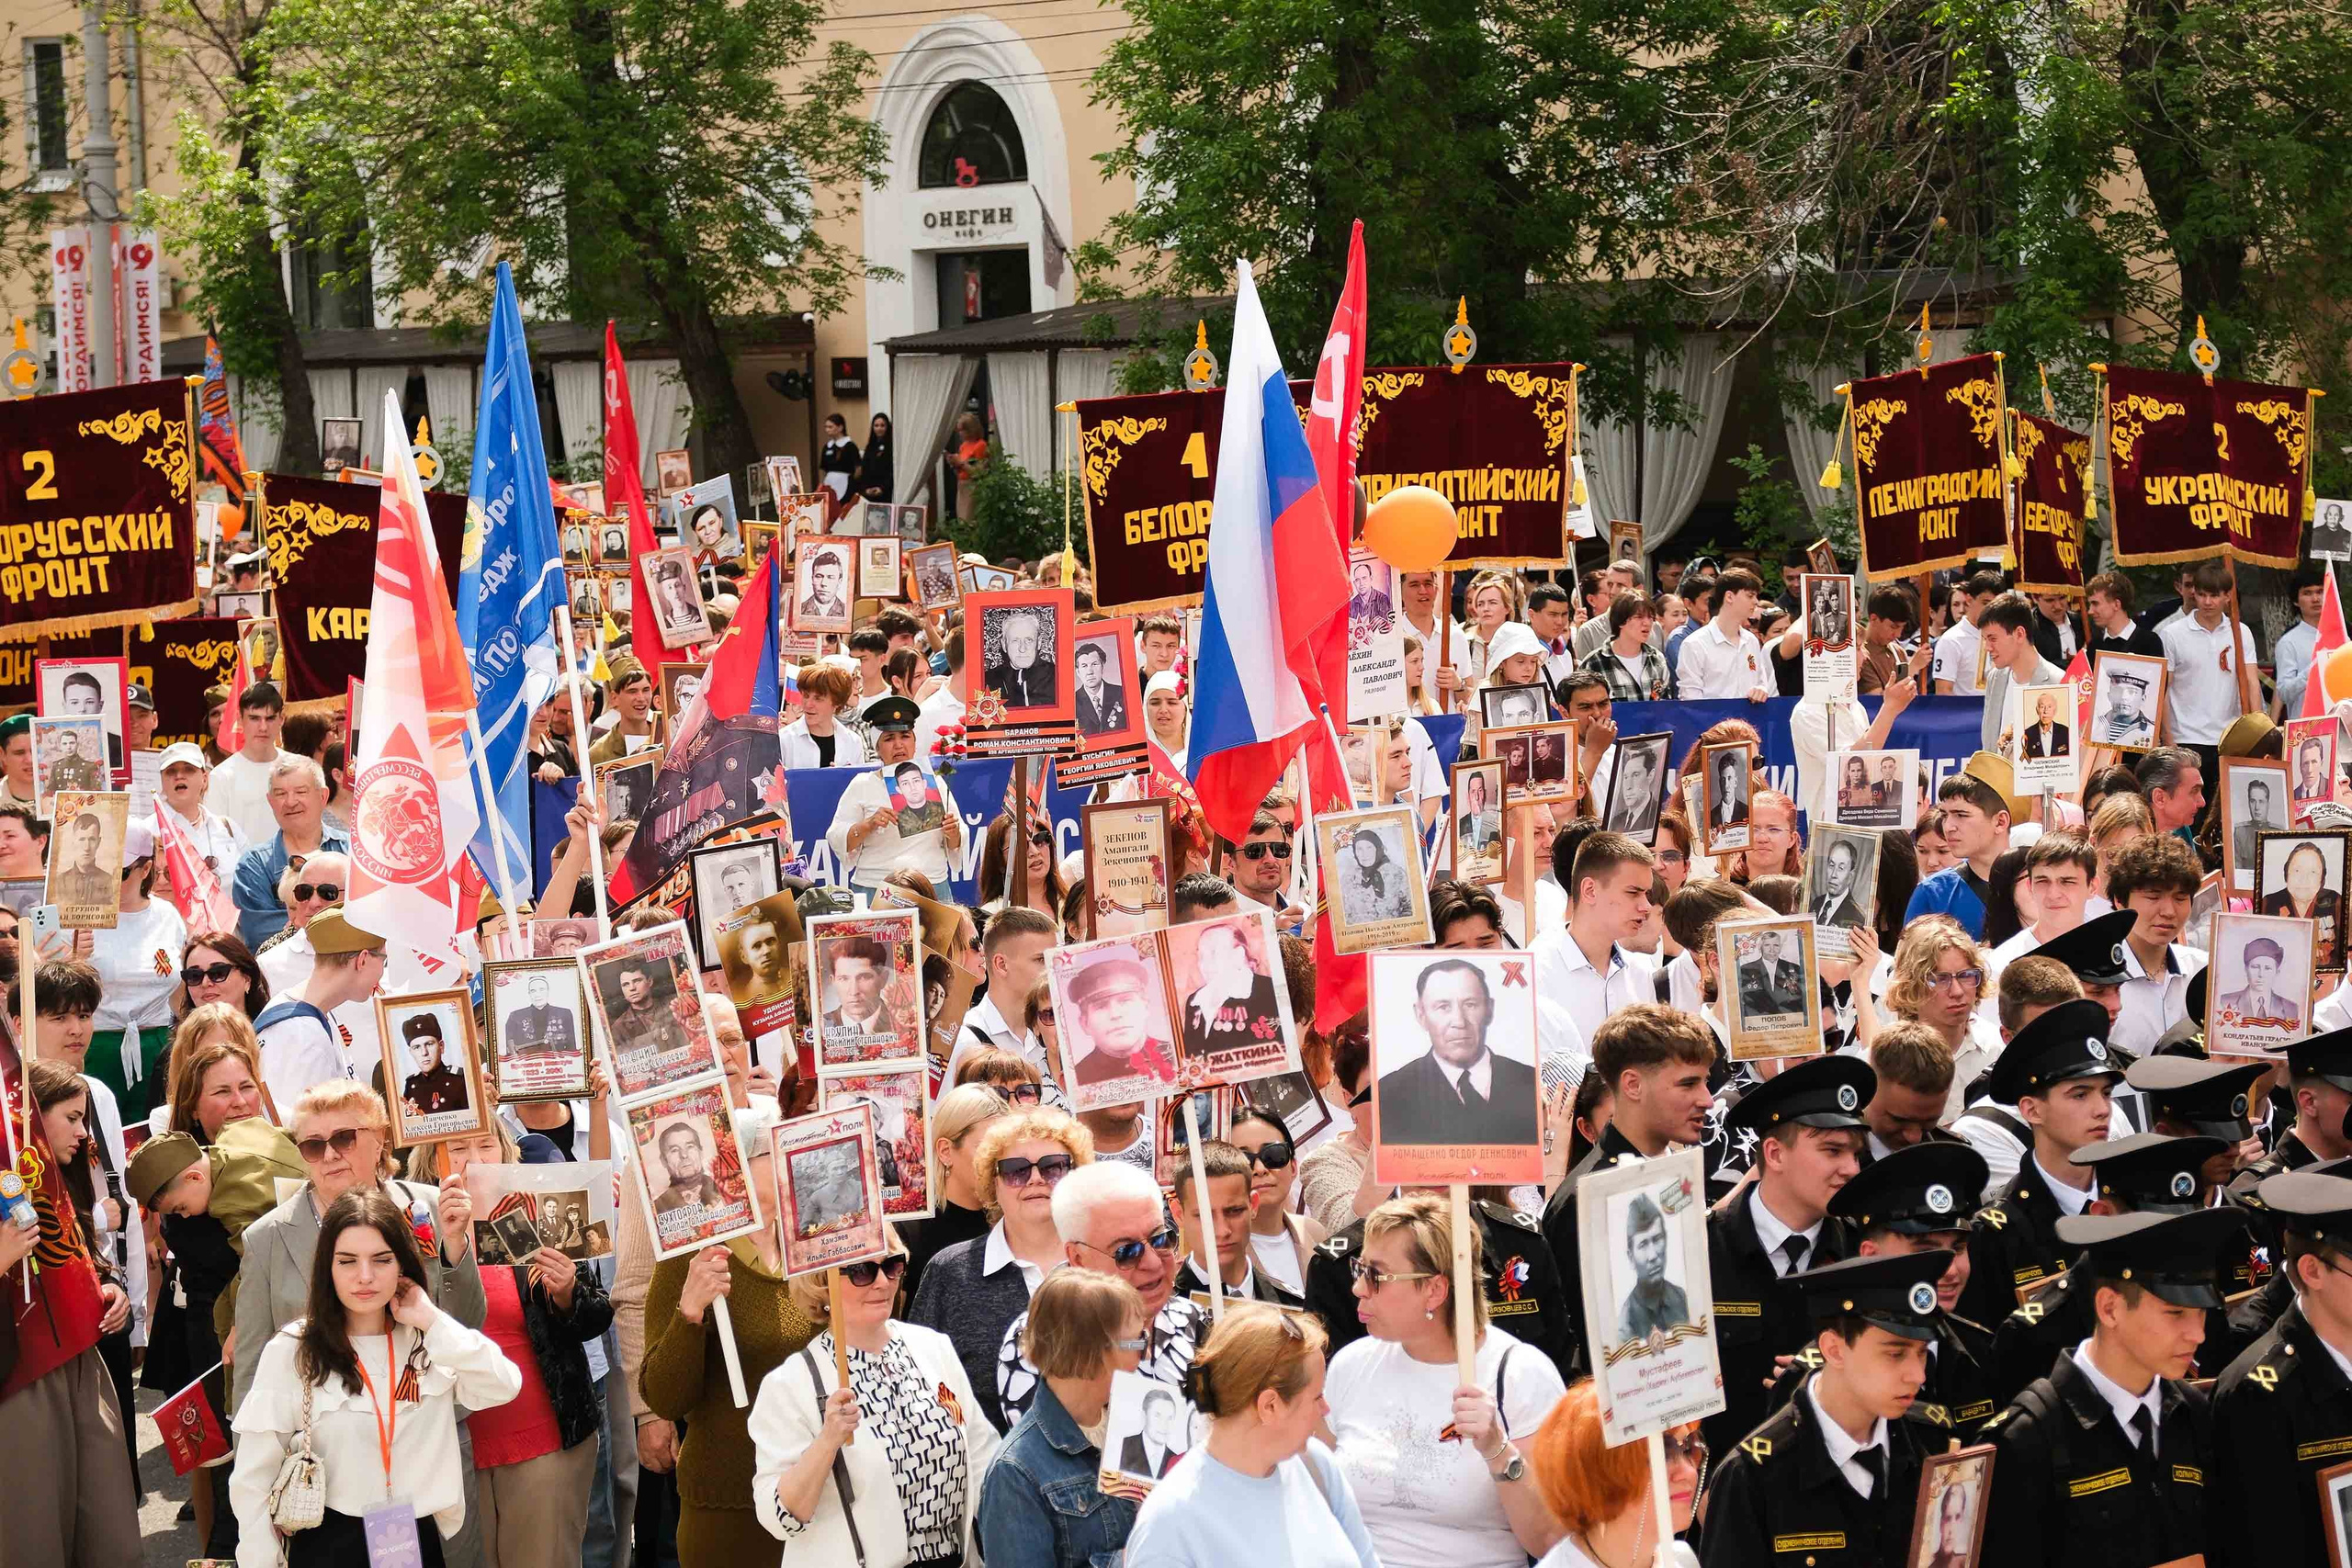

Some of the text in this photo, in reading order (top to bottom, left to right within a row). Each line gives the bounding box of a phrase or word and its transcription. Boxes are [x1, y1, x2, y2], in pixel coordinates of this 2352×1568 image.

[923, 208, 1013, 229] ОНЕГИН
[68, 245, 85, 272] 9
[130, 243, 153, 271] 9
[2213, 422, 2231, 461] 2
[1180, 432, 1209, 479] 1
[22, 450, 59, 501] 2
[2143, 472, 2290, 518] УКРАИНСКИЙ
[1124, 500, 1214, 546] БЕЛОР
[1918, 507, 1960, 544] РОНТ
[2189, 502, 2254, 540] ФРОНТ
[1166, 538, 1209, 576] ФР
[1, 556, 110, 604] ФРОНТ
[1351, 659, 1397, 673] АЛЕКСАНДР
[1363, 671, 1403, 684] ПАВЛОВИЧ
[1004, 727, 1039, 737] БАРАНОВ
[973, 737, 1070, 749] РОМАН КОНСТАНТИНОВИЧ
[998, 747, 1044, 755] АРТИЛЛЕРИЙСКИЙ
[1081, 749, 1115, 761] БУСЫГИН
[1063, 756, 1137, 775] ГЕОРГИЙ ЯКОВЛЕВИЧ
[1071, 773, 1095, 784] ЗАПАСНОЙ
[1094, 769, 1125, 780] СТРЕЛКОВЫЙ
[1103, 830, 1148, 843] ЗЕКЕНОВ
[1102, 844, 1149, 855] Амангали
[1102, 855, 1151, 866] Зекенович
[1107, 875, 1148, 888] 1910-1941
[752, 1013, 775, 1027] КУЗЬМА
[1770, 1022, 1803, 1031] Петрович
[825, 1023, 859, 1038] КРУПИН
[2223, 1032, 2265, 1042] КОНДРАТЬЕВ
[855, 1033, 899, 1046] СТЕПАНОВИЧ
[1210, 1043, 1281, 1066] ЖАТКИНА
[1125, 1082, 1166, 1098] Иванович
[423, 1112, 458, 1123] Панченко
[842, 1120, 865, 1133] ПОЛК
[1448, 1148, 1477, 1159] ФЕДОР
[1479, 1148, 1528, 1160] ДЕНИСОВИЧ
[658, 1203, 704, 1225] БУХТОЯРОВ
[659, 1219, 690, 1237] НИКОЛАЙ
[688, 1202, 745, 1226] АЛЕКСАНДРОВИЧ
[820, 1233, 849, 1247] Хамзяев
[806, 1243, 866, 1263] Ильяс Габбасович
[1638, 1359, 1683, 1380] Мустафеев
[1659, 1398, 1722, 1426] Бессмертный полк
